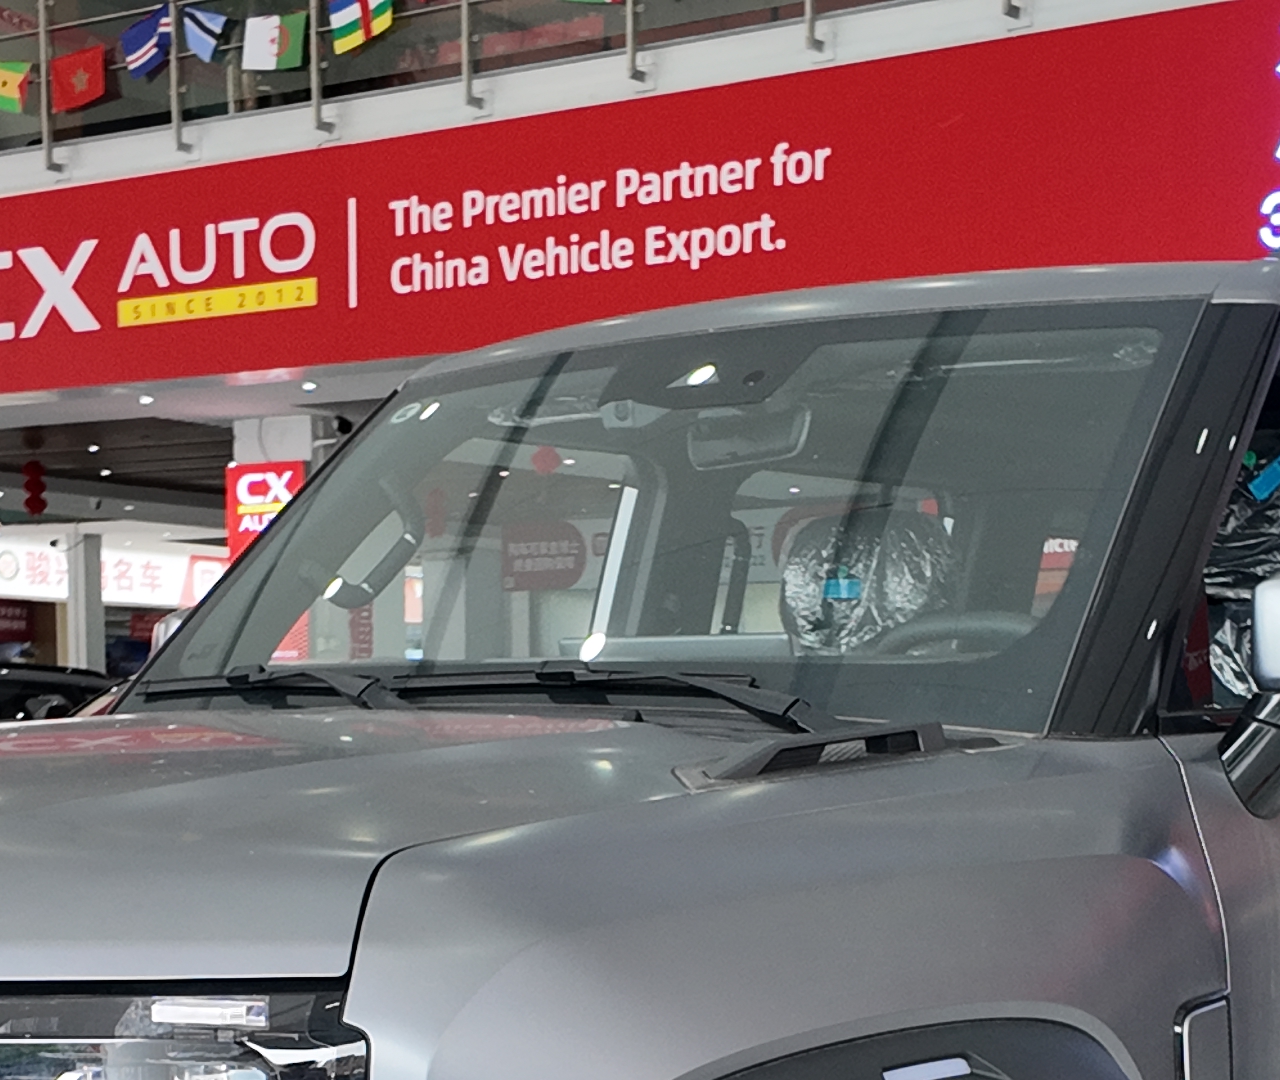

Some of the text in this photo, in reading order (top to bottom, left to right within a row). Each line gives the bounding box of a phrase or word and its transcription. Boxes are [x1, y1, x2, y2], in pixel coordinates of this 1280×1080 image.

[389, 141, 832, 237] The Premier Partner for
[117, 211, 317, 293] AUTO
[389, 212, 788, 295] China Vehicle Export.
[131, 285, 307, 321] SINCE 2012
[236, 470, 294, 504] CX
